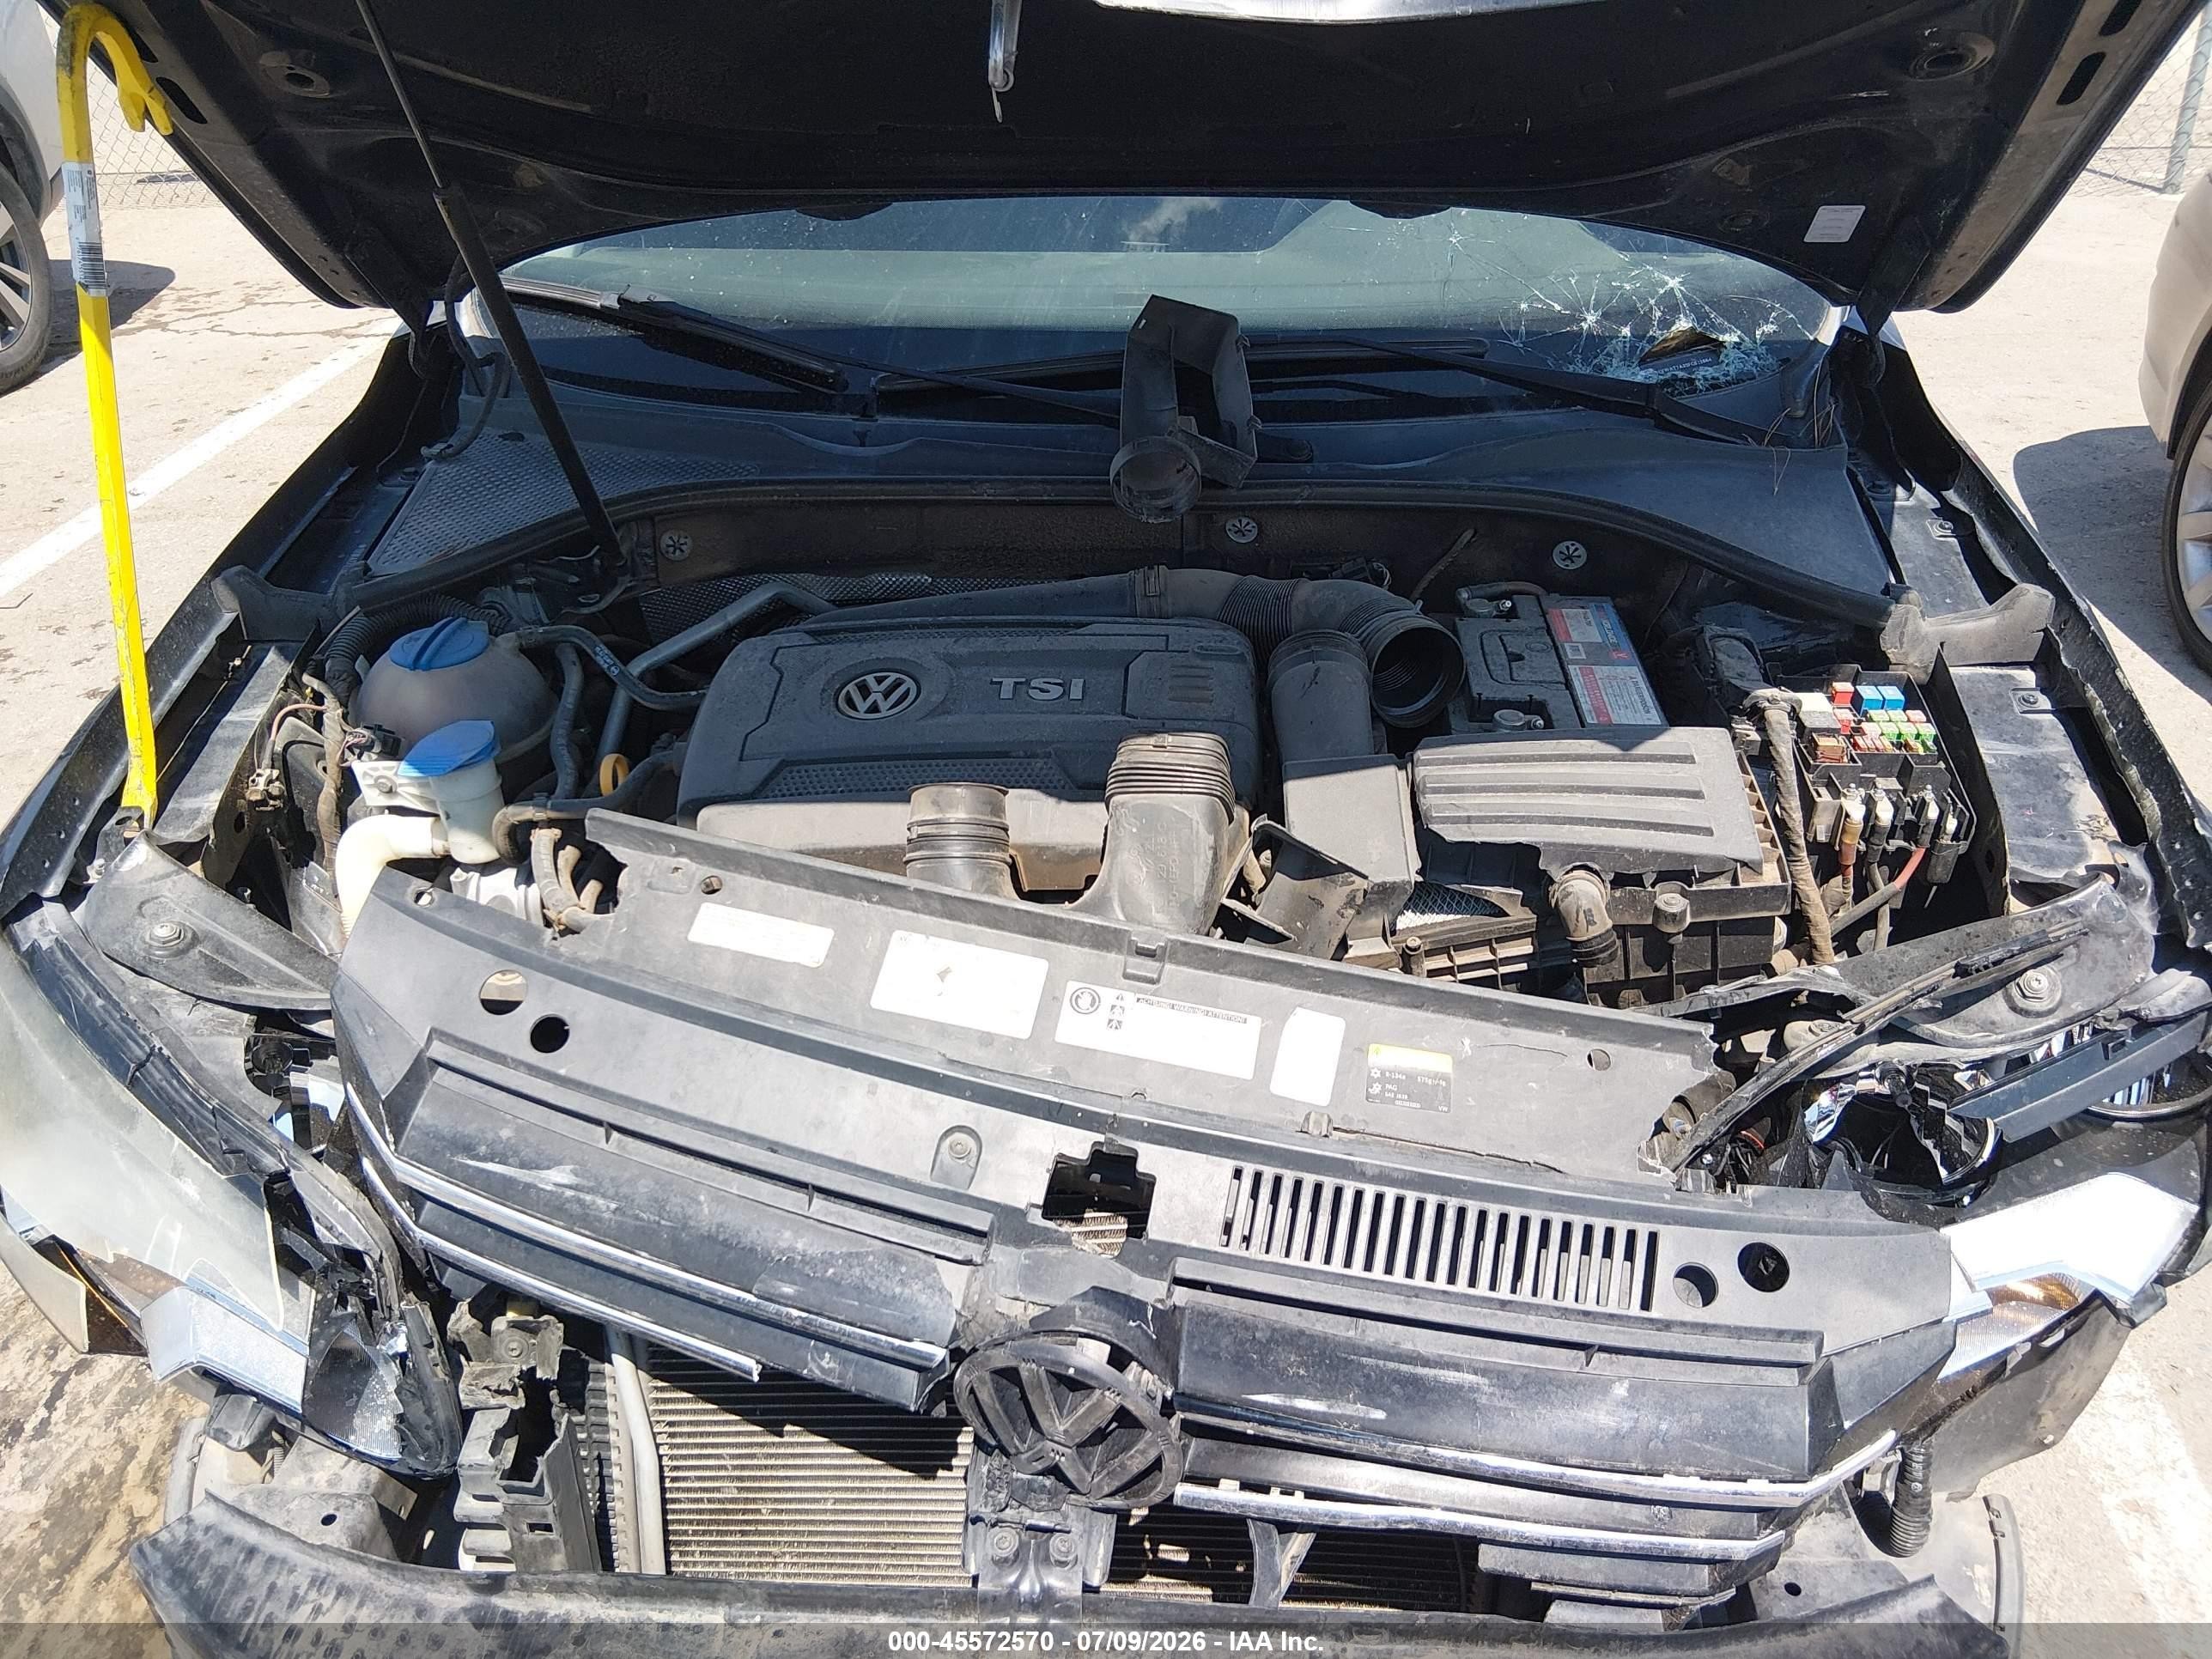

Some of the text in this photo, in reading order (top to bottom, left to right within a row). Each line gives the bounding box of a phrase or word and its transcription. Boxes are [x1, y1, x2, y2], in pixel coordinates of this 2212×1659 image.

[992, 677, 1086, 702] TSI
[1174, 1004, 1207, 1016] WARNING!
[1208, 1010, 1245, 1024] ATTENTION!
